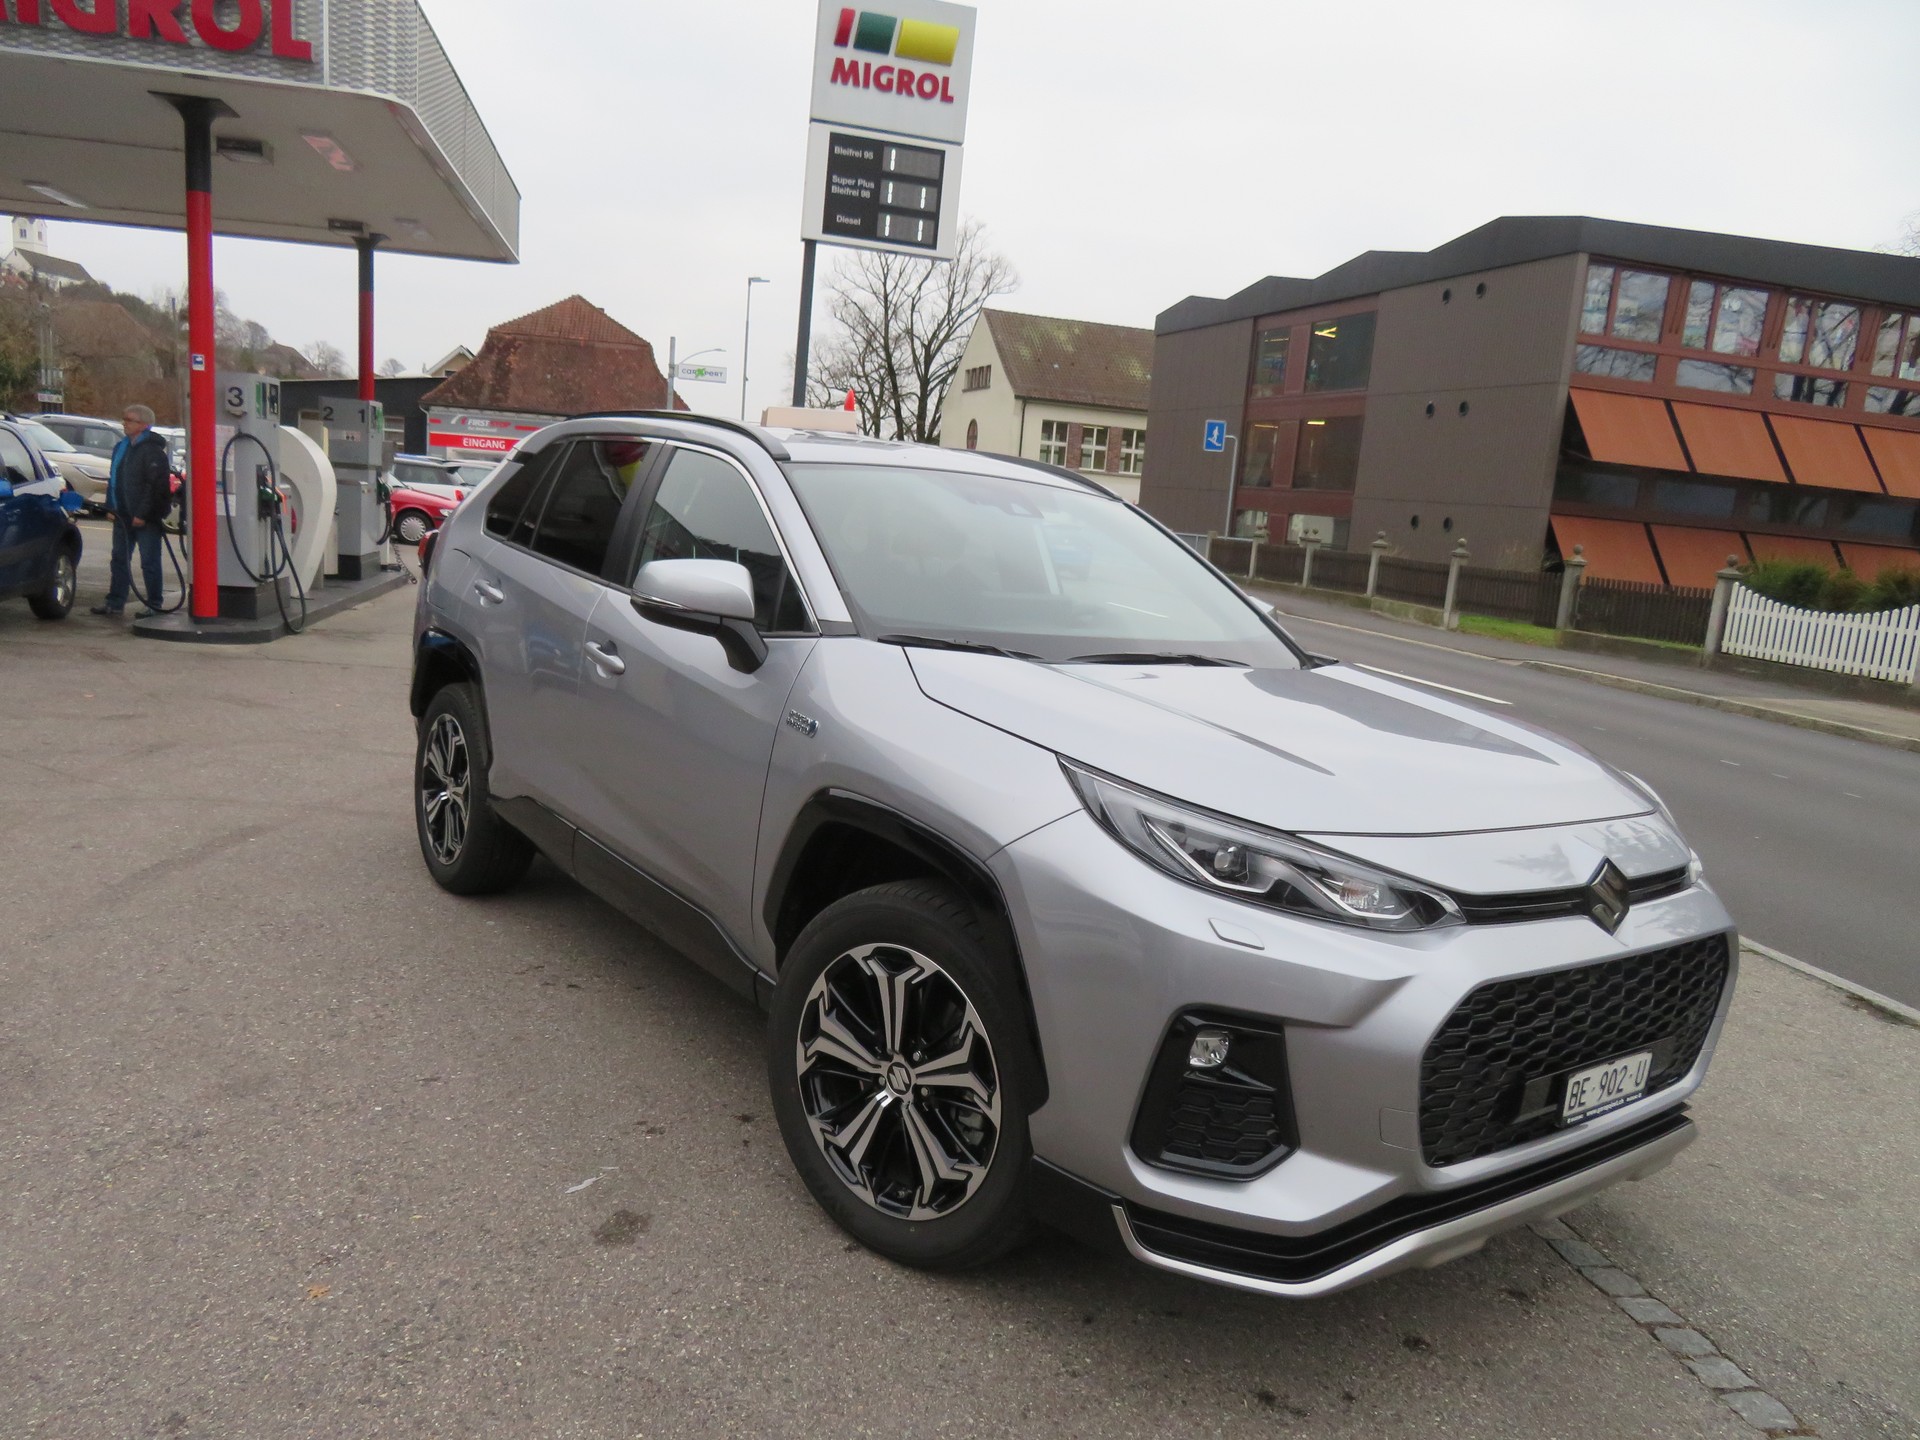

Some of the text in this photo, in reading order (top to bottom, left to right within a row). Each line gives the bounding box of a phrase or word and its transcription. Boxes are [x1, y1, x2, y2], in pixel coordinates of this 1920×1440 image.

[830, 57, 954, 104] MIGROL
[834, 145, 862, 158] Bleifrei
[863, 150, 874, 160] 95
[832, 174, 875, 189] Super Plus
[831, 185, 859, 197] Bleifrei
[836, 214, 861, 226] Diesel
[227, 386, 244, 407] 3
[323, 406, 334, 421] 2
[358, 408, 366, 423] 1
[462, 438, 506, 449] EINGANG
